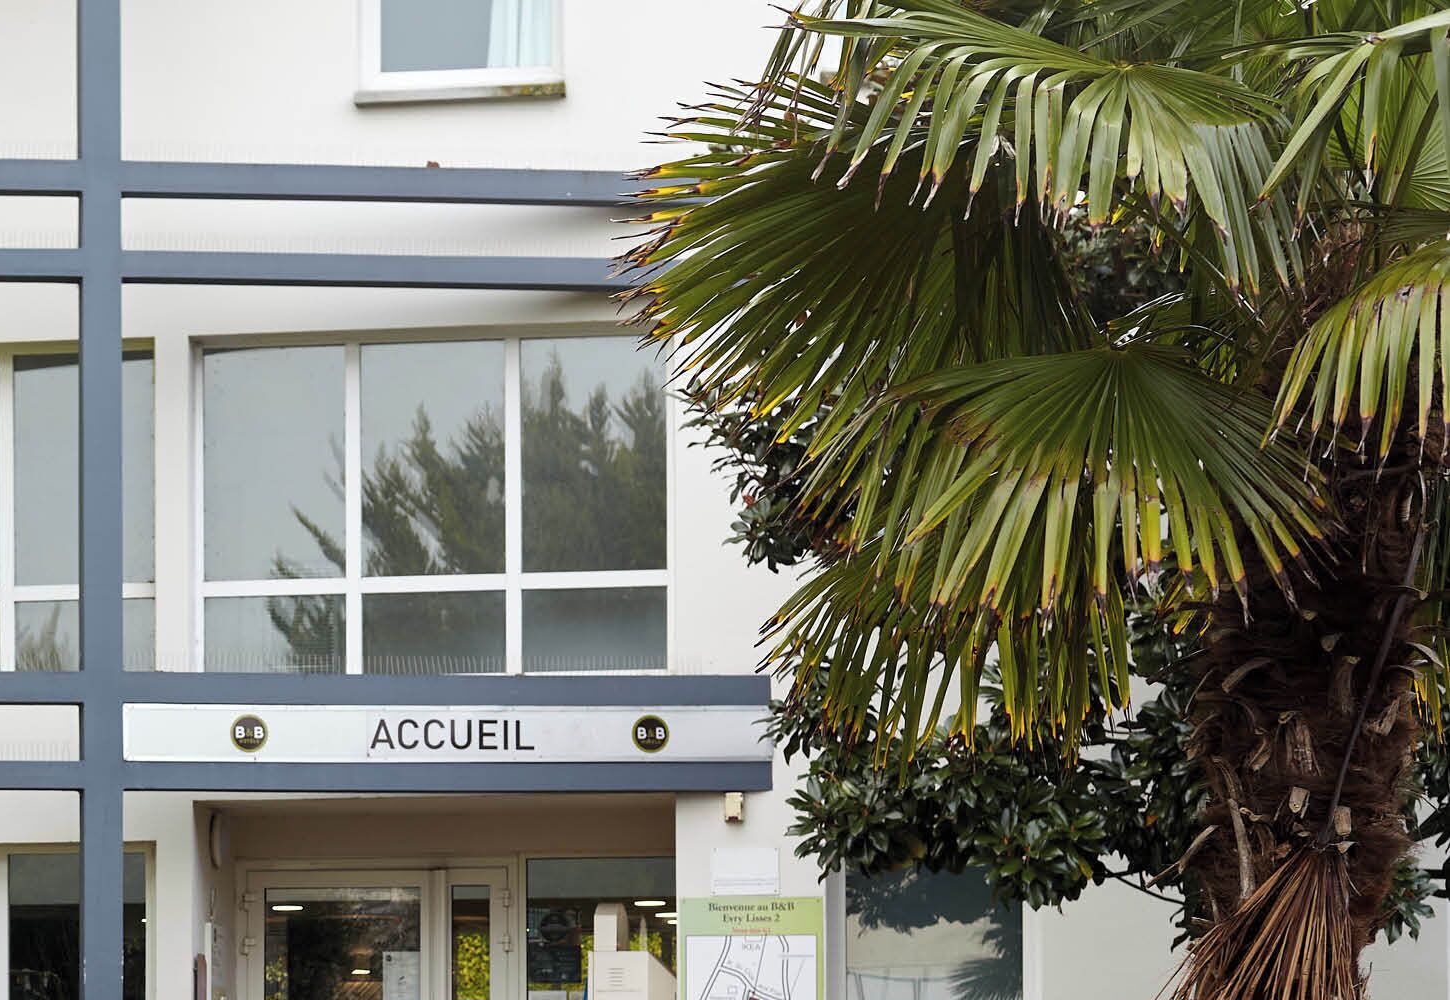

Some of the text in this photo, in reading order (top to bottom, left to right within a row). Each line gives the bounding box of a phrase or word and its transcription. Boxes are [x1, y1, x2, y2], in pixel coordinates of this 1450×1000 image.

[235, 725, 264, 739] B&B
[370, 718, 535, 751] ACCUEIL
[637, 726, 666, 740] B&B
[708, 902, 755, 912] Bienvenue
[771, 901, 795, 911] B&B
[722, 913, 781, 925] Evry Lisses 2
